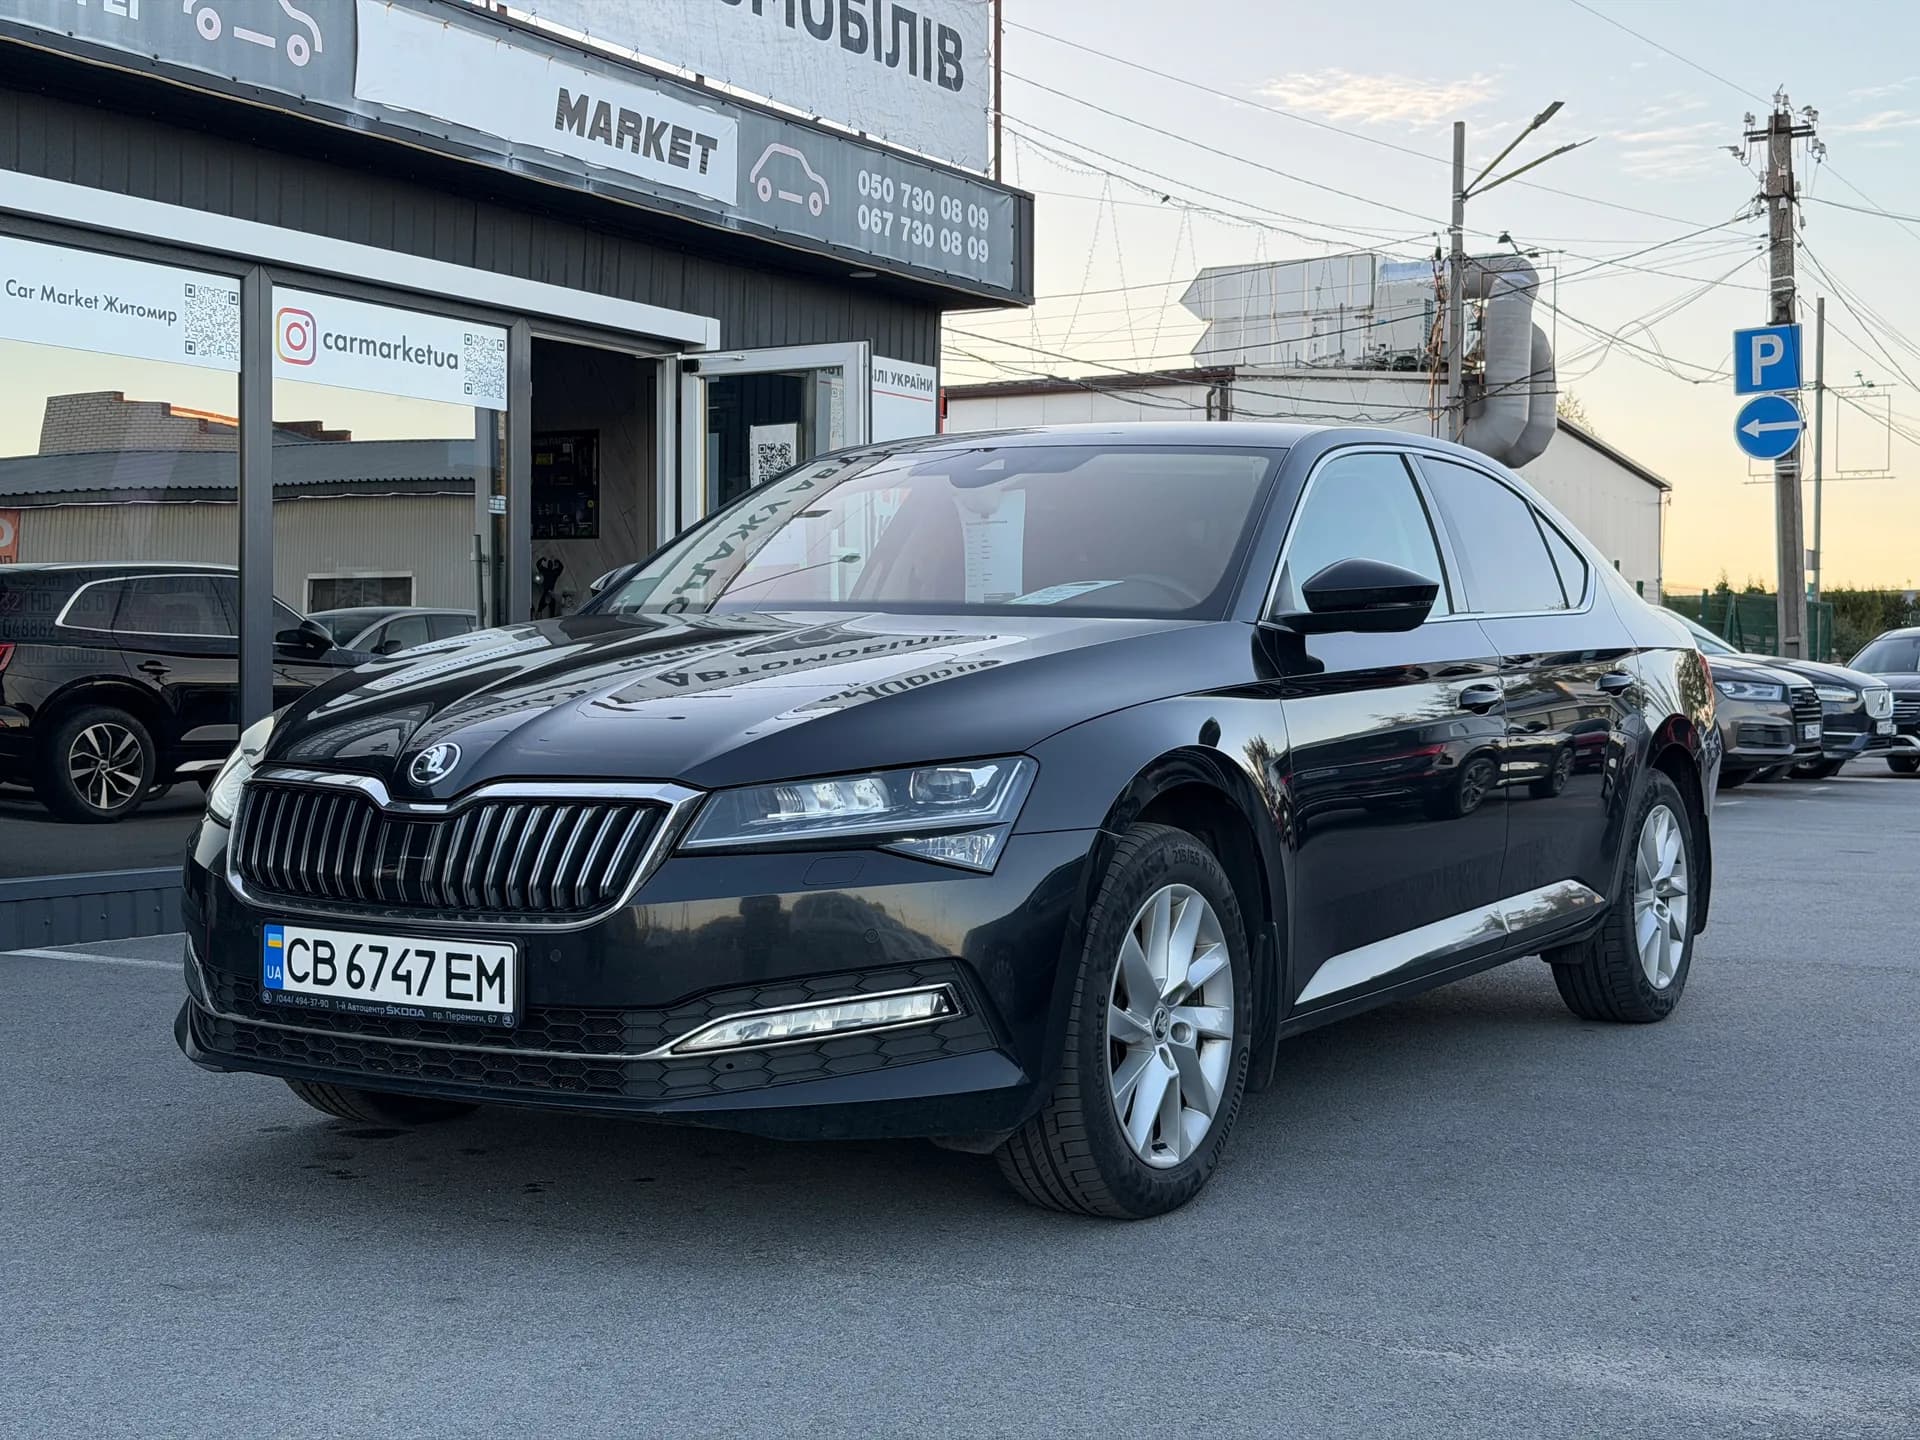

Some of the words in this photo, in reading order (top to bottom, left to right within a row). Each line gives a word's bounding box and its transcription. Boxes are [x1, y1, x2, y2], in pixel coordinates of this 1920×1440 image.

[720, 0, 964, 93] ОБІЛІВ
[554, 87, 718, 175] MARKET
[858, 169, 894, 202] 050
[901, 179, 934, 214] 730
[940, 191, 963, 223] 08
[968, 199, 988, 231] 09
[858, 204, 894, 237] 067
[901, 214, 934, 248] 730
[940, 224, 962, 256] 08
[968, 232, 988, 263] 09
[5, 279, 36, 301] Car
[40, 285, 99, 310] Market
[103, 295, 178, 326] Житомир
[323, 328, 459, 370] carmarketua
[1752, 334, 1784, 386] P
[872, 368, 888, 384] ІЛІ
[891, 371, 933, 393] УКРАЇНИ
[266, 964, 282, 981] UA
[286, 938, 338, 986] CB
[346, 943, 437, 996] 6747
[445, 951, 506, 1004] EM
[295, 996, 329, 1009] 494-37-90
[347, 1002, 385, 1016] Автоцентр
[488, 1014, 498, 1025] 67
